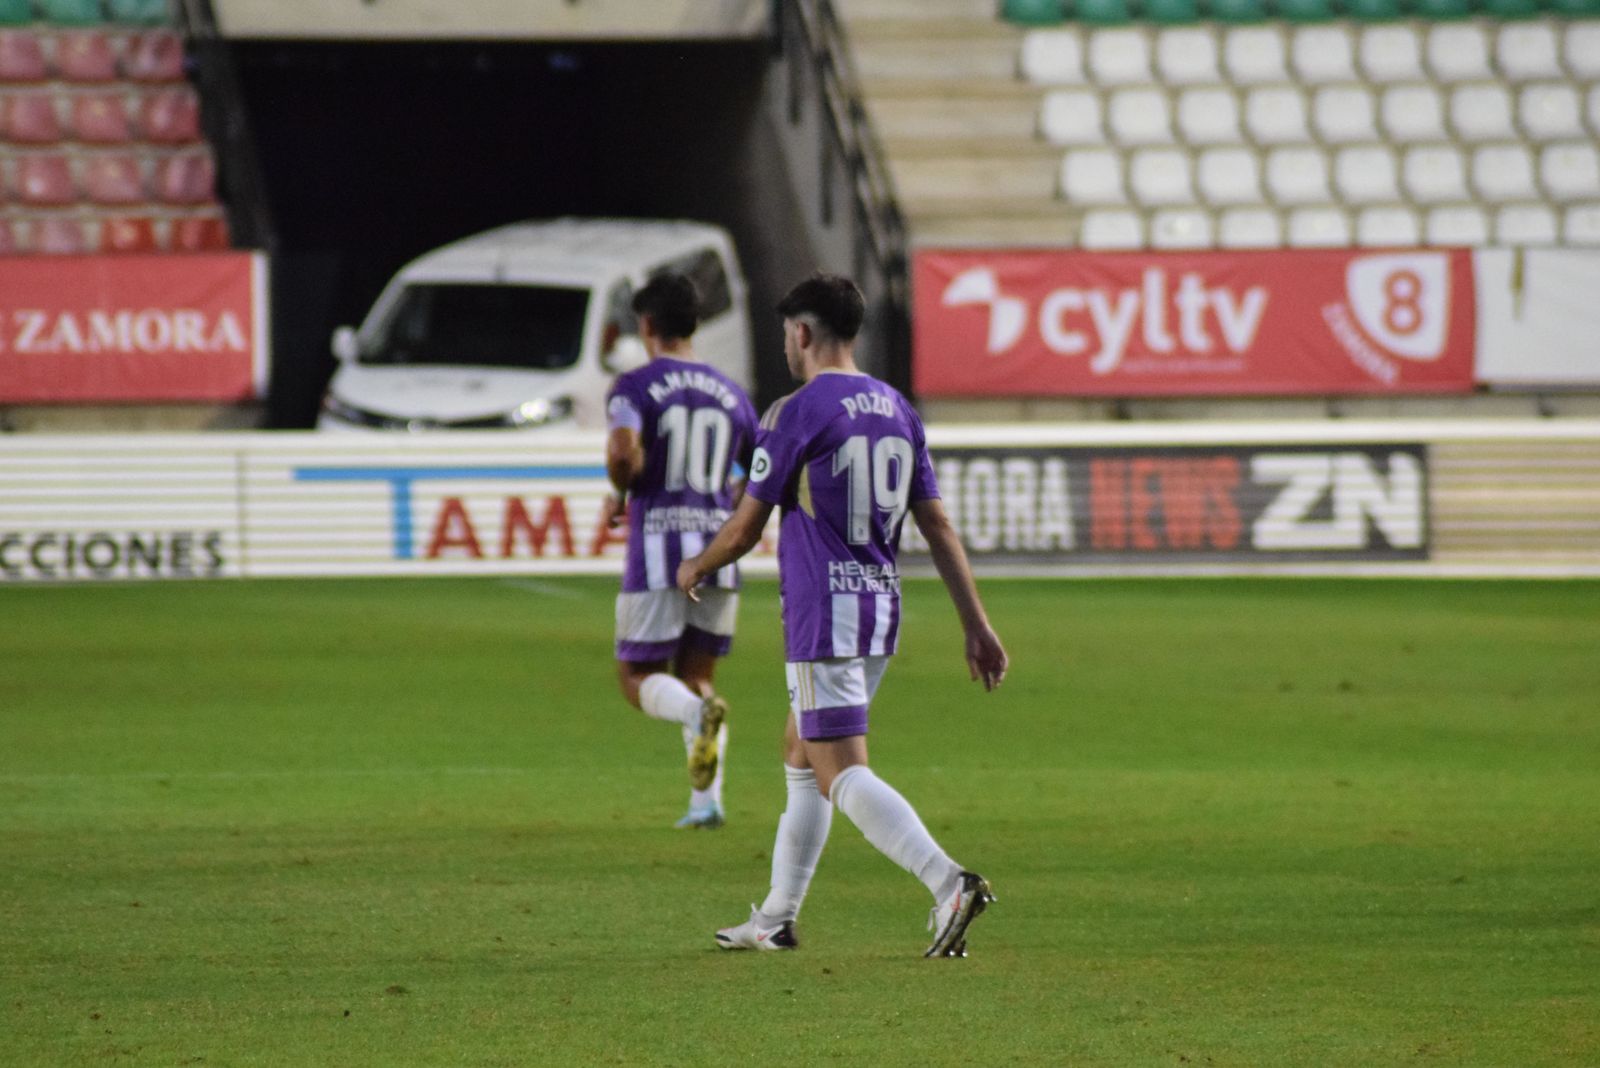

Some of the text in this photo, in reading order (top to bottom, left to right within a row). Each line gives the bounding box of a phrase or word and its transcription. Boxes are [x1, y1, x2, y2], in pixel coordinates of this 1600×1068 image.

[13, 309, 246, 352] ZAMORA
[1040, 266, 1268, 375] cyltv
[1384, 269, 1423, 337] 8
[657, 405, 732, 495] 10
[840, 392, 894, 420] POZO
[832, 435, 914, 545] 19
[1089, 456, 1241, 550] NEWS
[1250, 451, 1422, 550] ZN
